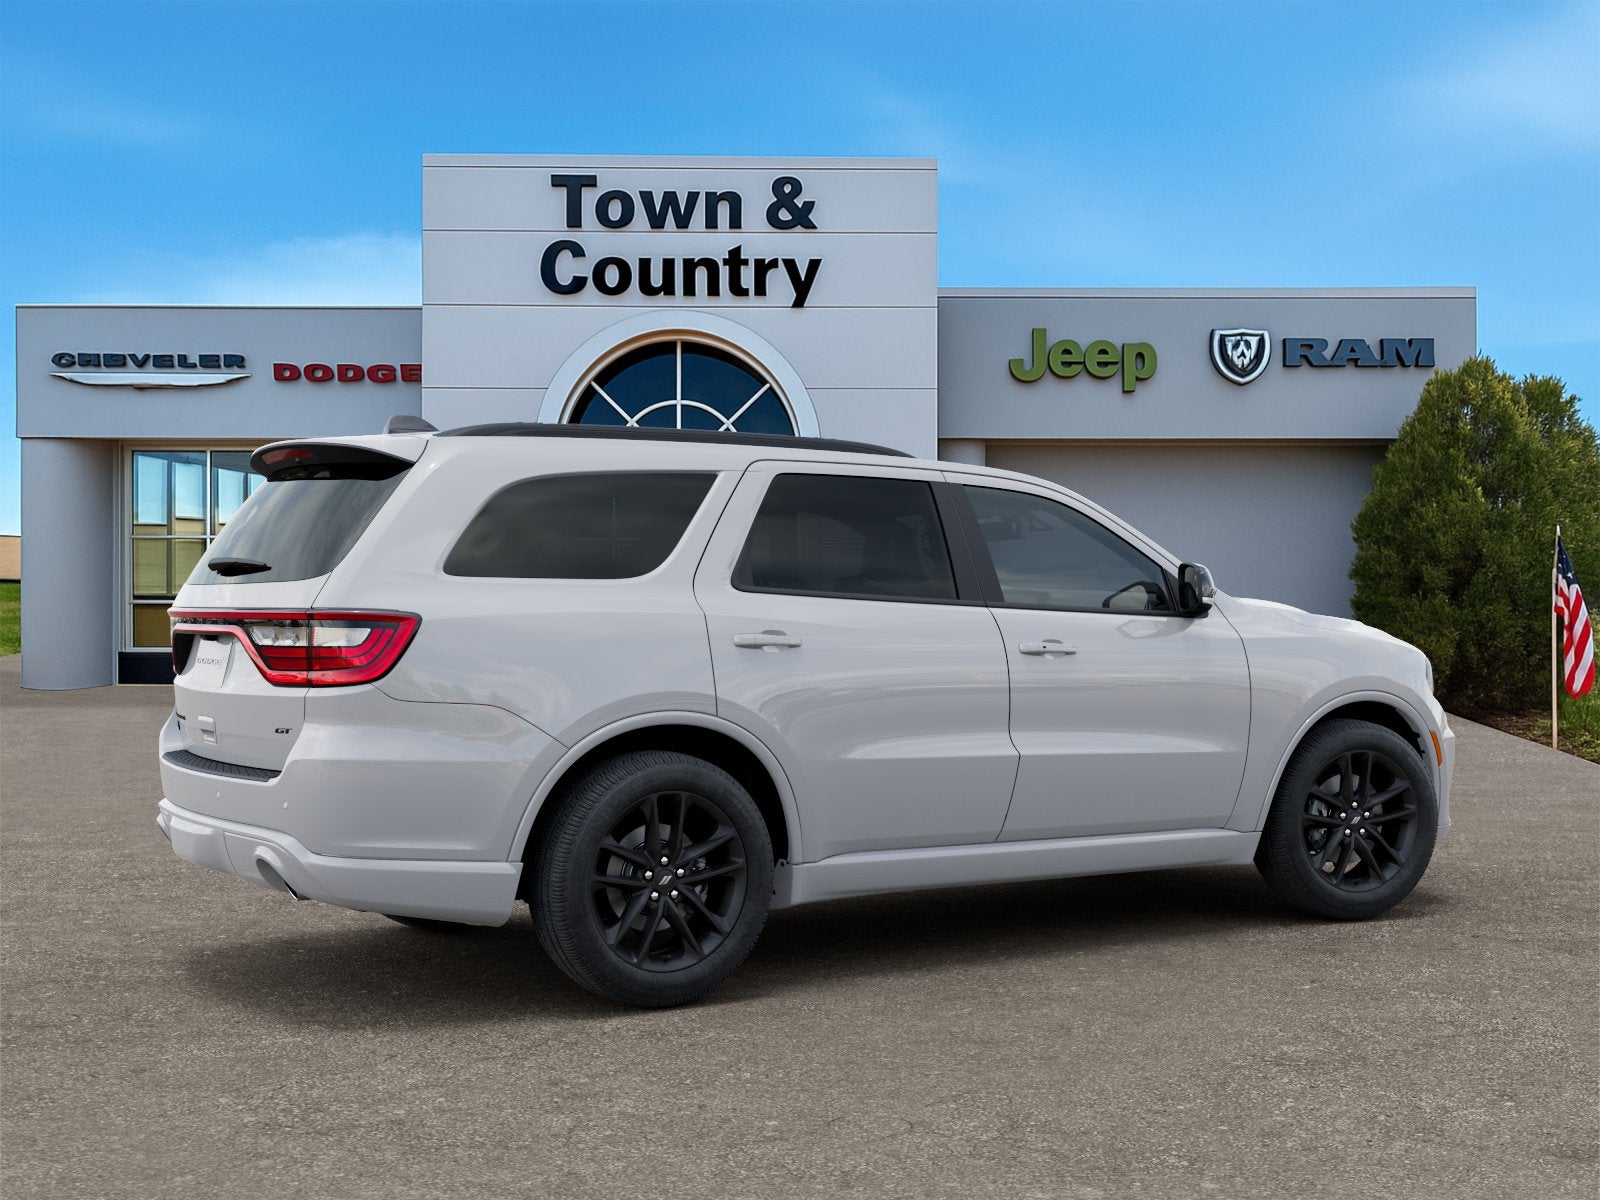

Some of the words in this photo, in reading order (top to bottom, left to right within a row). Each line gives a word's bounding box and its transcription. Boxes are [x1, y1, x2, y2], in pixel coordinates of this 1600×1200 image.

[551, 174, 742, 229] Town
[766, 176, 818, 230] &
[540, 239, 822, 308] Country
[273, 362, 422, 383] DODGE
[1007, 328, 1157, 392] Jeep
[1282, 337, 1435, 368] RAM
[275, 727, 292, 735] GT
